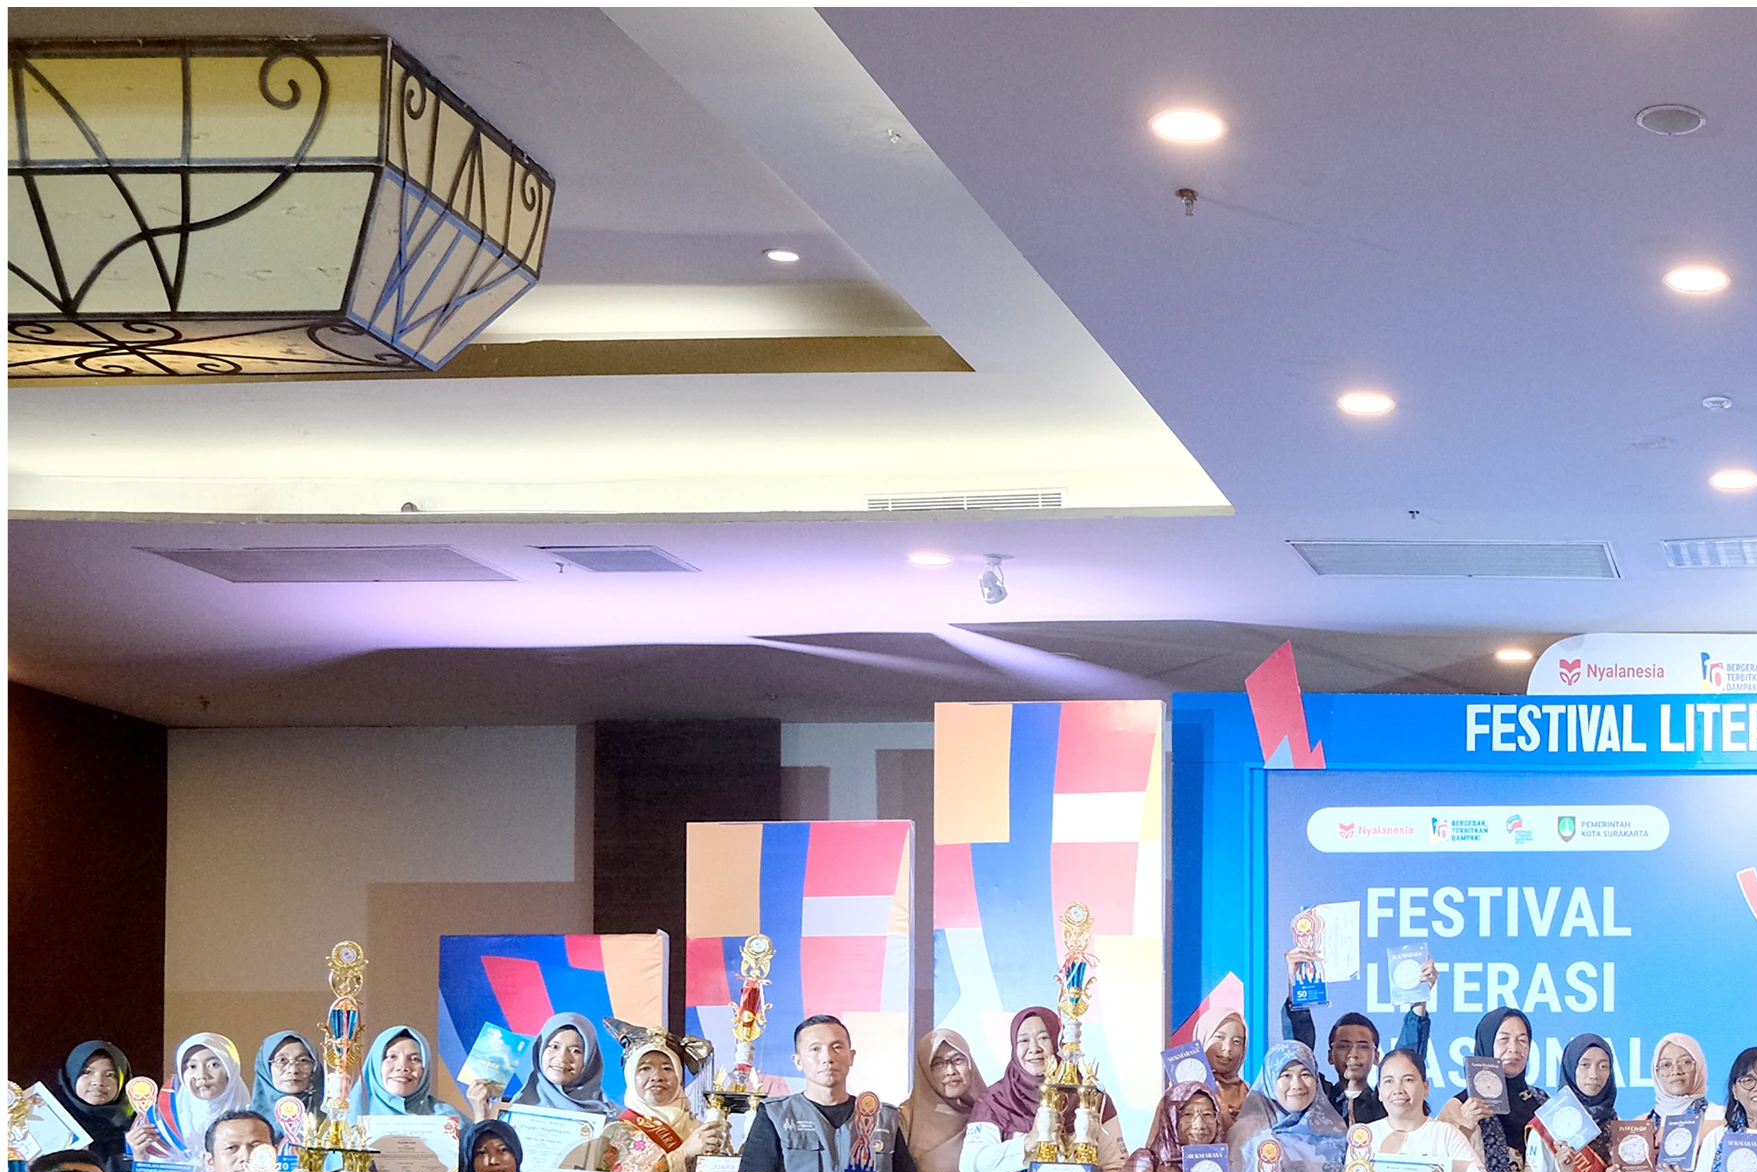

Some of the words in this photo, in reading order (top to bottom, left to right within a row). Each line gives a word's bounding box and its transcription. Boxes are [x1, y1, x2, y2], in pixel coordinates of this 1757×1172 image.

[1587, 664, 1664, 681] Nyalanesia
[1466, 703, 1646, 753] FESTIVAL
[1358, 825, 1414, 836] Nyalanesia
[1367, 887, 1631, 938] FESTIVAL
[1297, 990, 1307, 998] 50
[1367, 963, 1615, 1013] LTERASI
